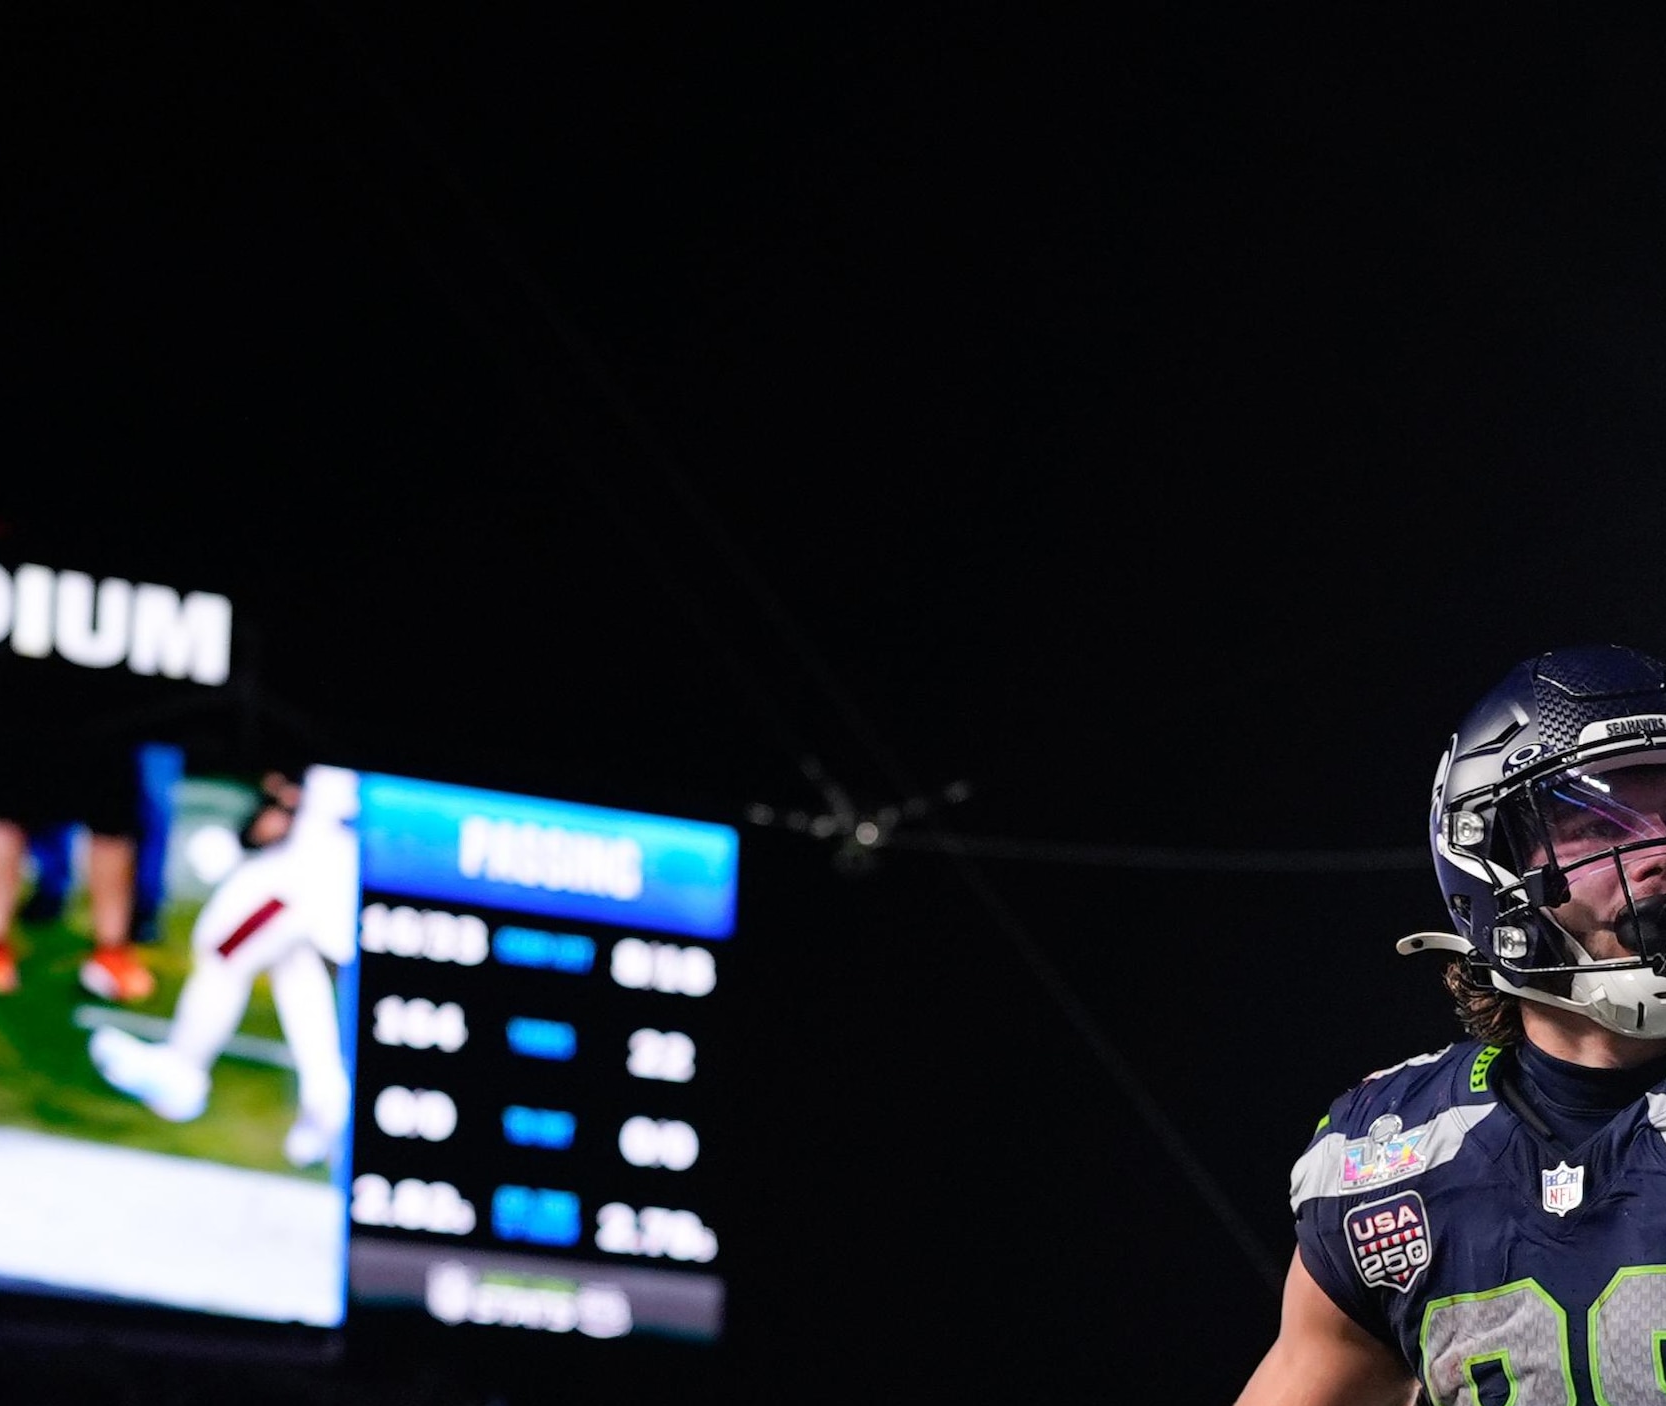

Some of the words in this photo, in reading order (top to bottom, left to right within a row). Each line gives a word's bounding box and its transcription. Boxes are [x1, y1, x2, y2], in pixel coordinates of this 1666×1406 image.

[1605, 717, 1666, 737] SEAHAWKS
[1550, 1187, 1576, 1206] NFL
[1353, 1205, 1419, 1241] USA
[1360, 1238, 1428, 1283] 250
